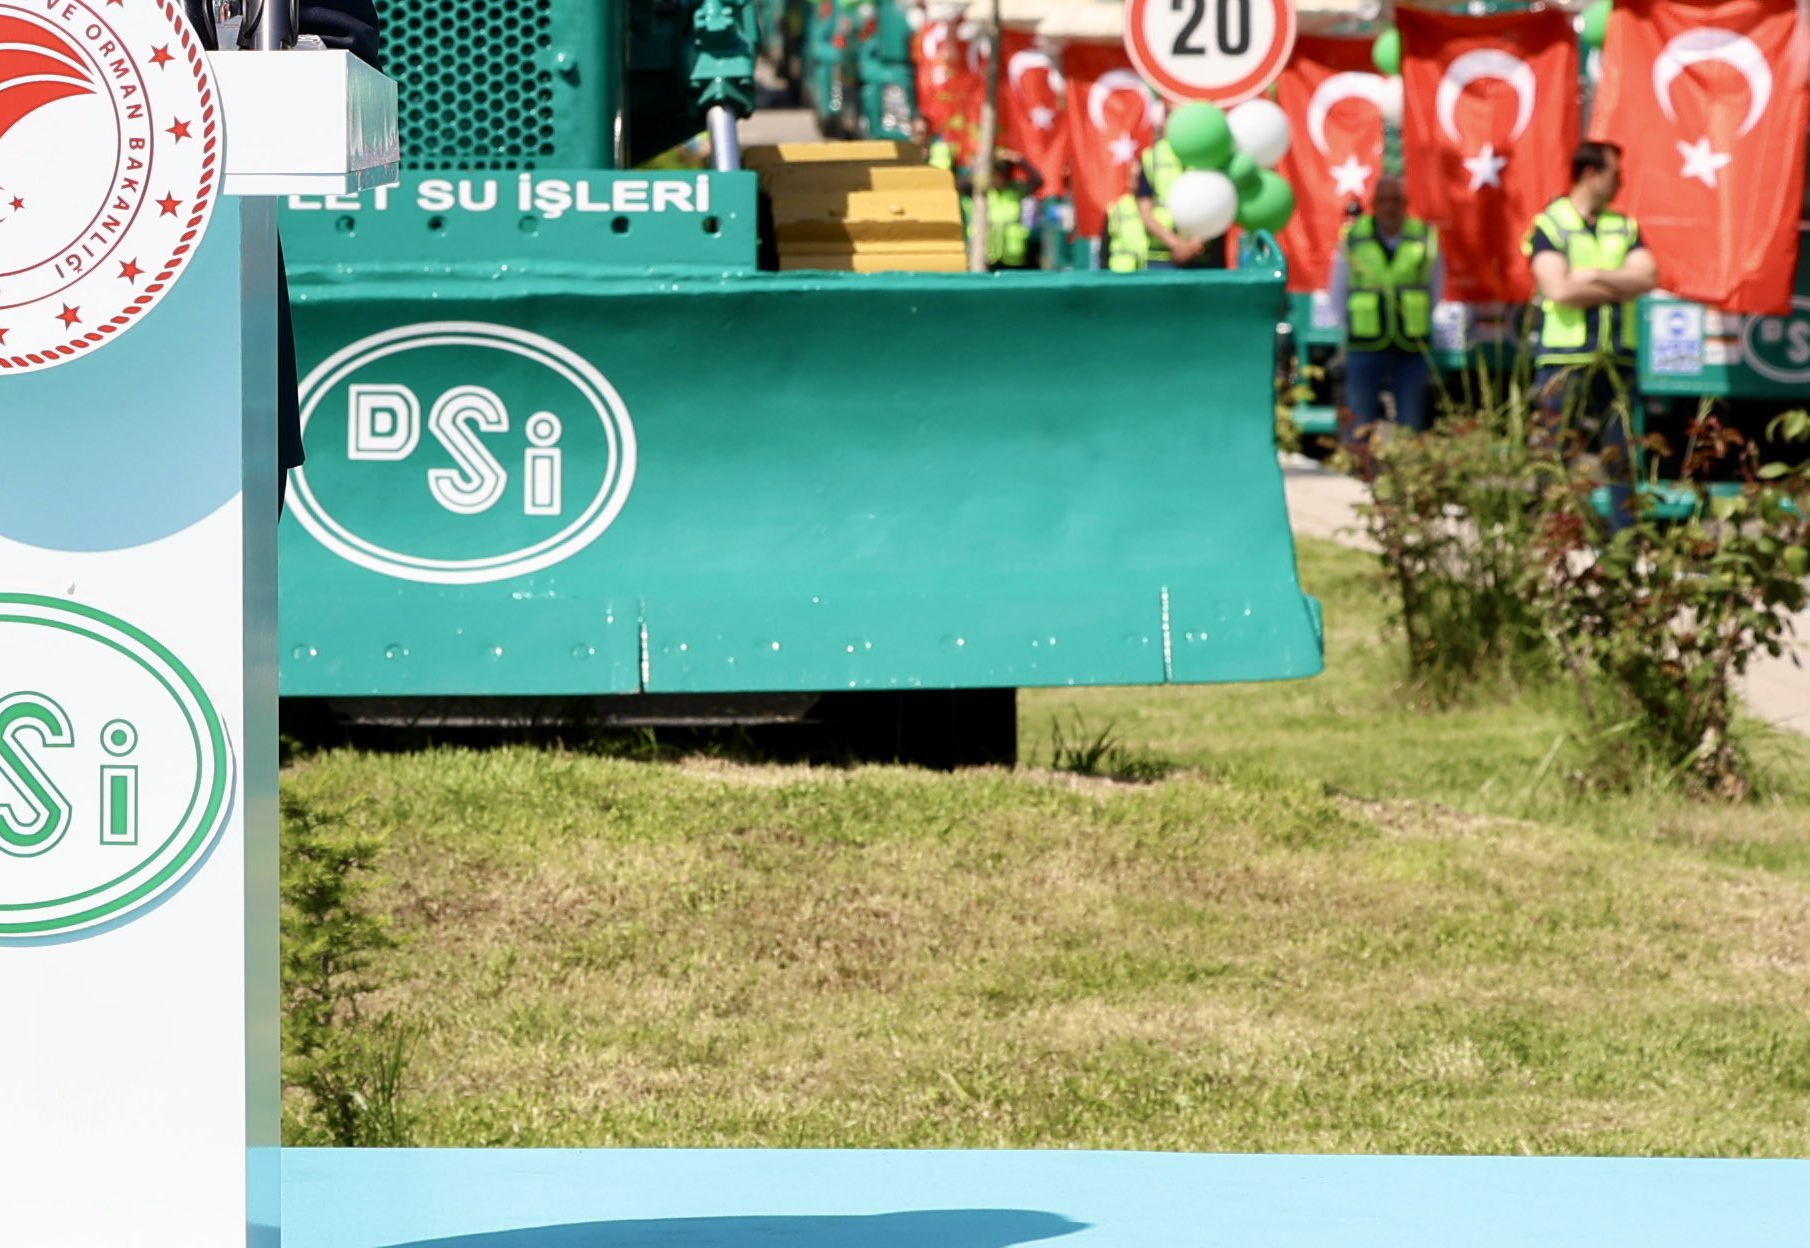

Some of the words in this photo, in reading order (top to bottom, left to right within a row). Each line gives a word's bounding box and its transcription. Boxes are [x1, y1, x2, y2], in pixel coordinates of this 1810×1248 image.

[85, 23, 144, 120] ORMAN
[54, 136, 146, 280] BAKANLIĞI
[416, 179, 498, 212] SU
[518, 173, 710, 219] İŞLERİ
